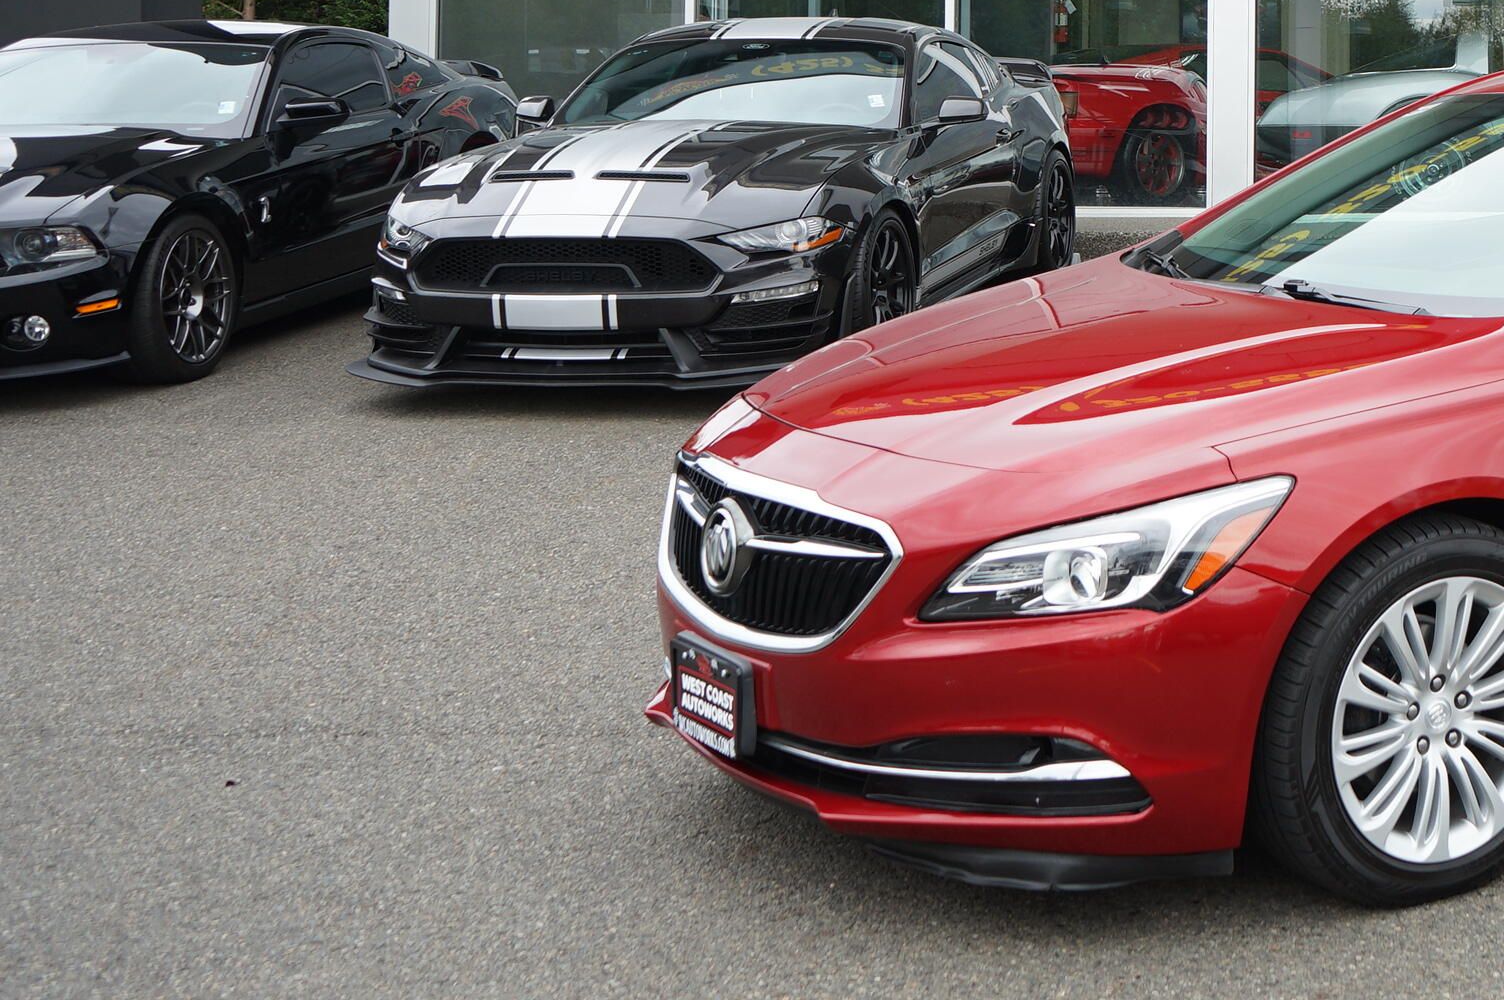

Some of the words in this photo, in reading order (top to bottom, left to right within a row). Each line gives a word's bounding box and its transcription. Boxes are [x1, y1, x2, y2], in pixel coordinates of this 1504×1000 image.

[681, 673, 706, 698] WEST
[706, 684, 734, 711] COAST
[681, 692, 734, 732] AUTOWORKS
